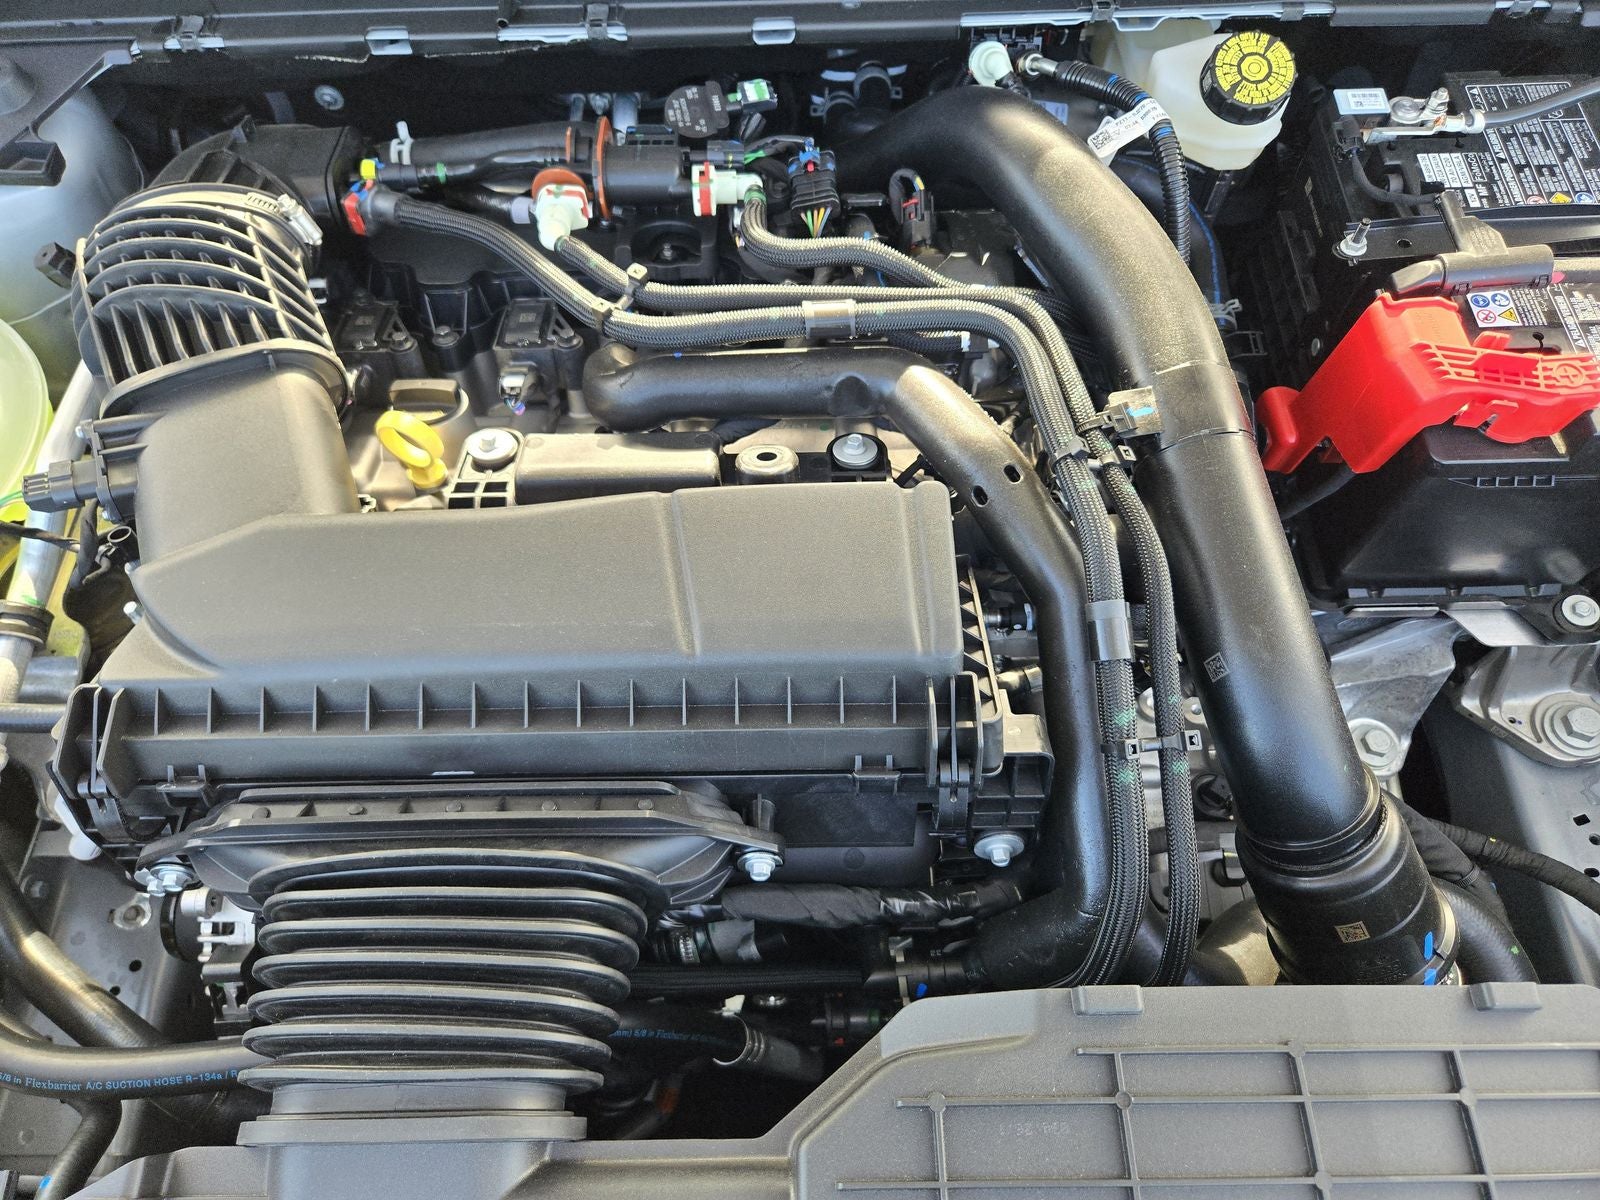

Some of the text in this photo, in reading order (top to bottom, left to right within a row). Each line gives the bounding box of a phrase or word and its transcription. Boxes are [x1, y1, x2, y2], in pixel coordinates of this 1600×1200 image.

[1467, 152, 1484, 181] FoMoCo
[13, 1075, 22, 1084] in
[25, 1077, 82, 1091] Flexbarrier
[86, 1081, 102, 1090] A/C
[105, 1079, 151, 1090] SUCTION
[154, 1076, 183, 1086] HOSE
[185, 1072, 222, 1083] R-134a
